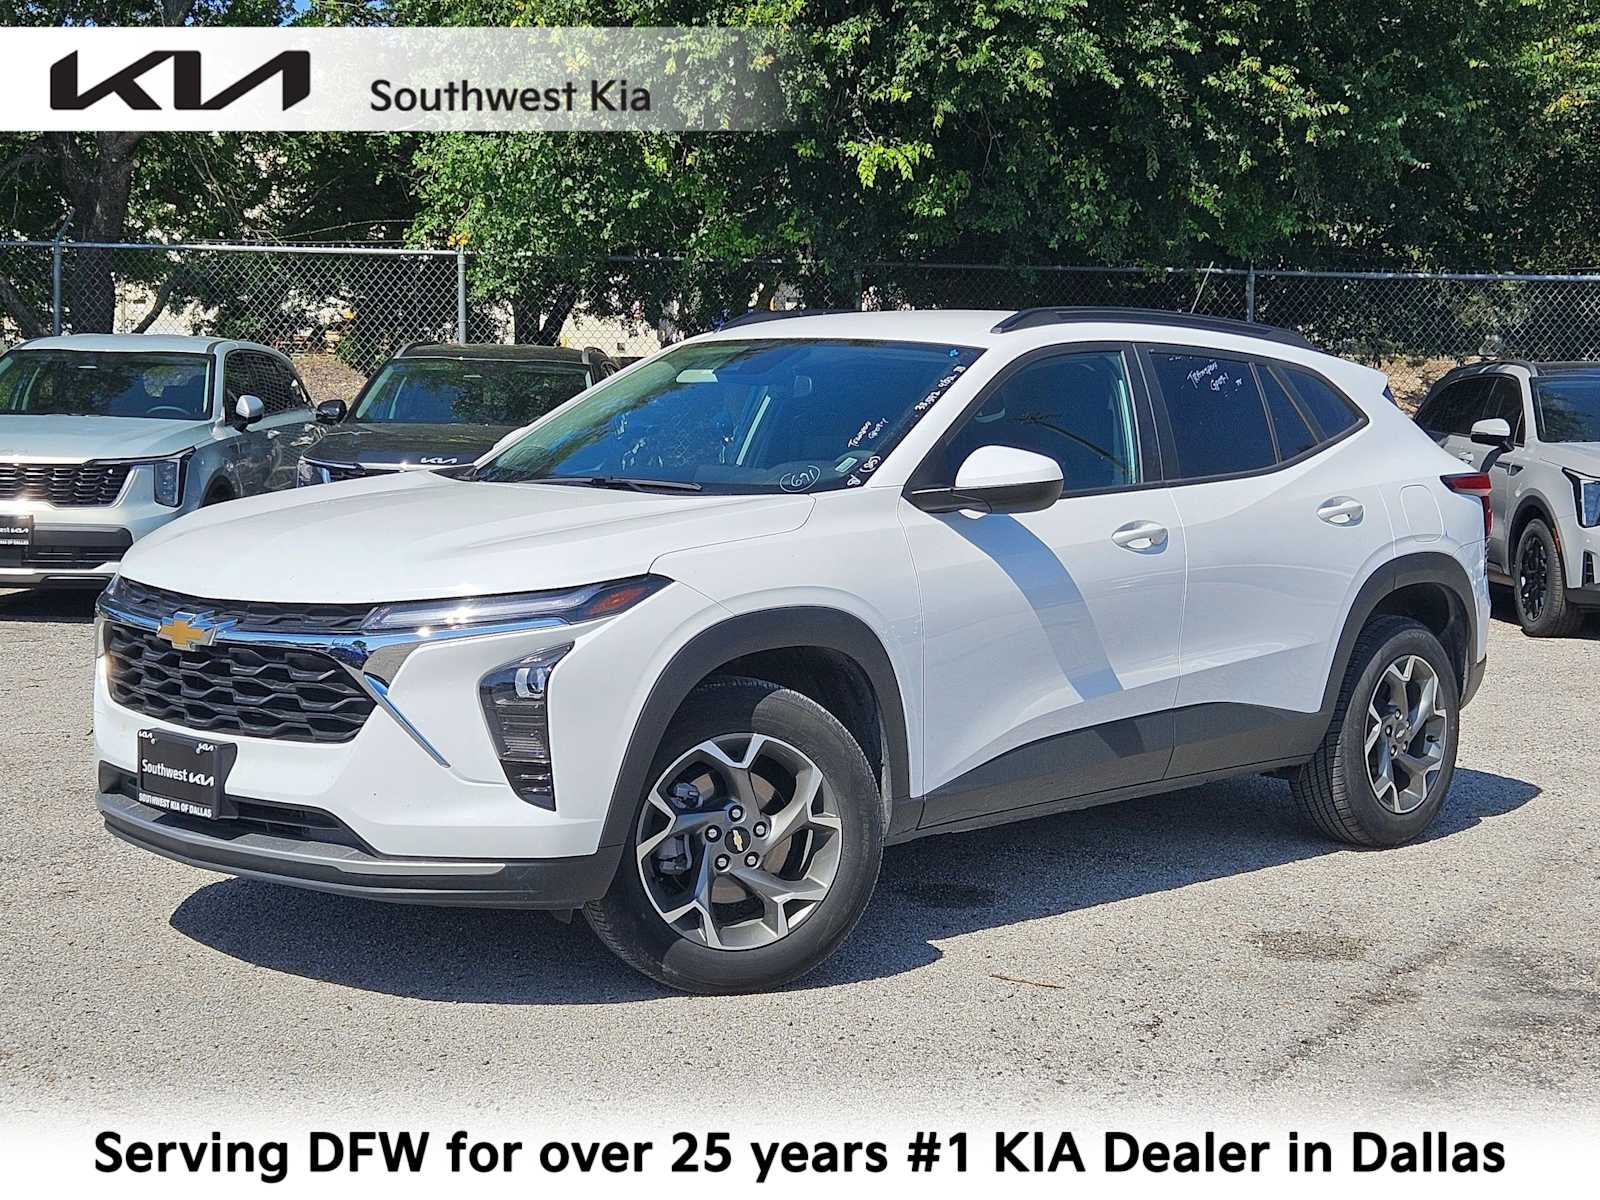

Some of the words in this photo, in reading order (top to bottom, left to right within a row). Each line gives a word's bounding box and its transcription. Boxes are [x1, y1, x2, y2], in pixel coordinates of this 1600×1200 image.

[142, 759, 188, 782] Southwest
[188, 772, 215, 787] KIA
[139, 792, 170, 809] SOUTHWEST
[170, 800, 180, 811] KIA
[180, 803, 188, 813] OF
[189, 805, 212, 818] DALLAS
